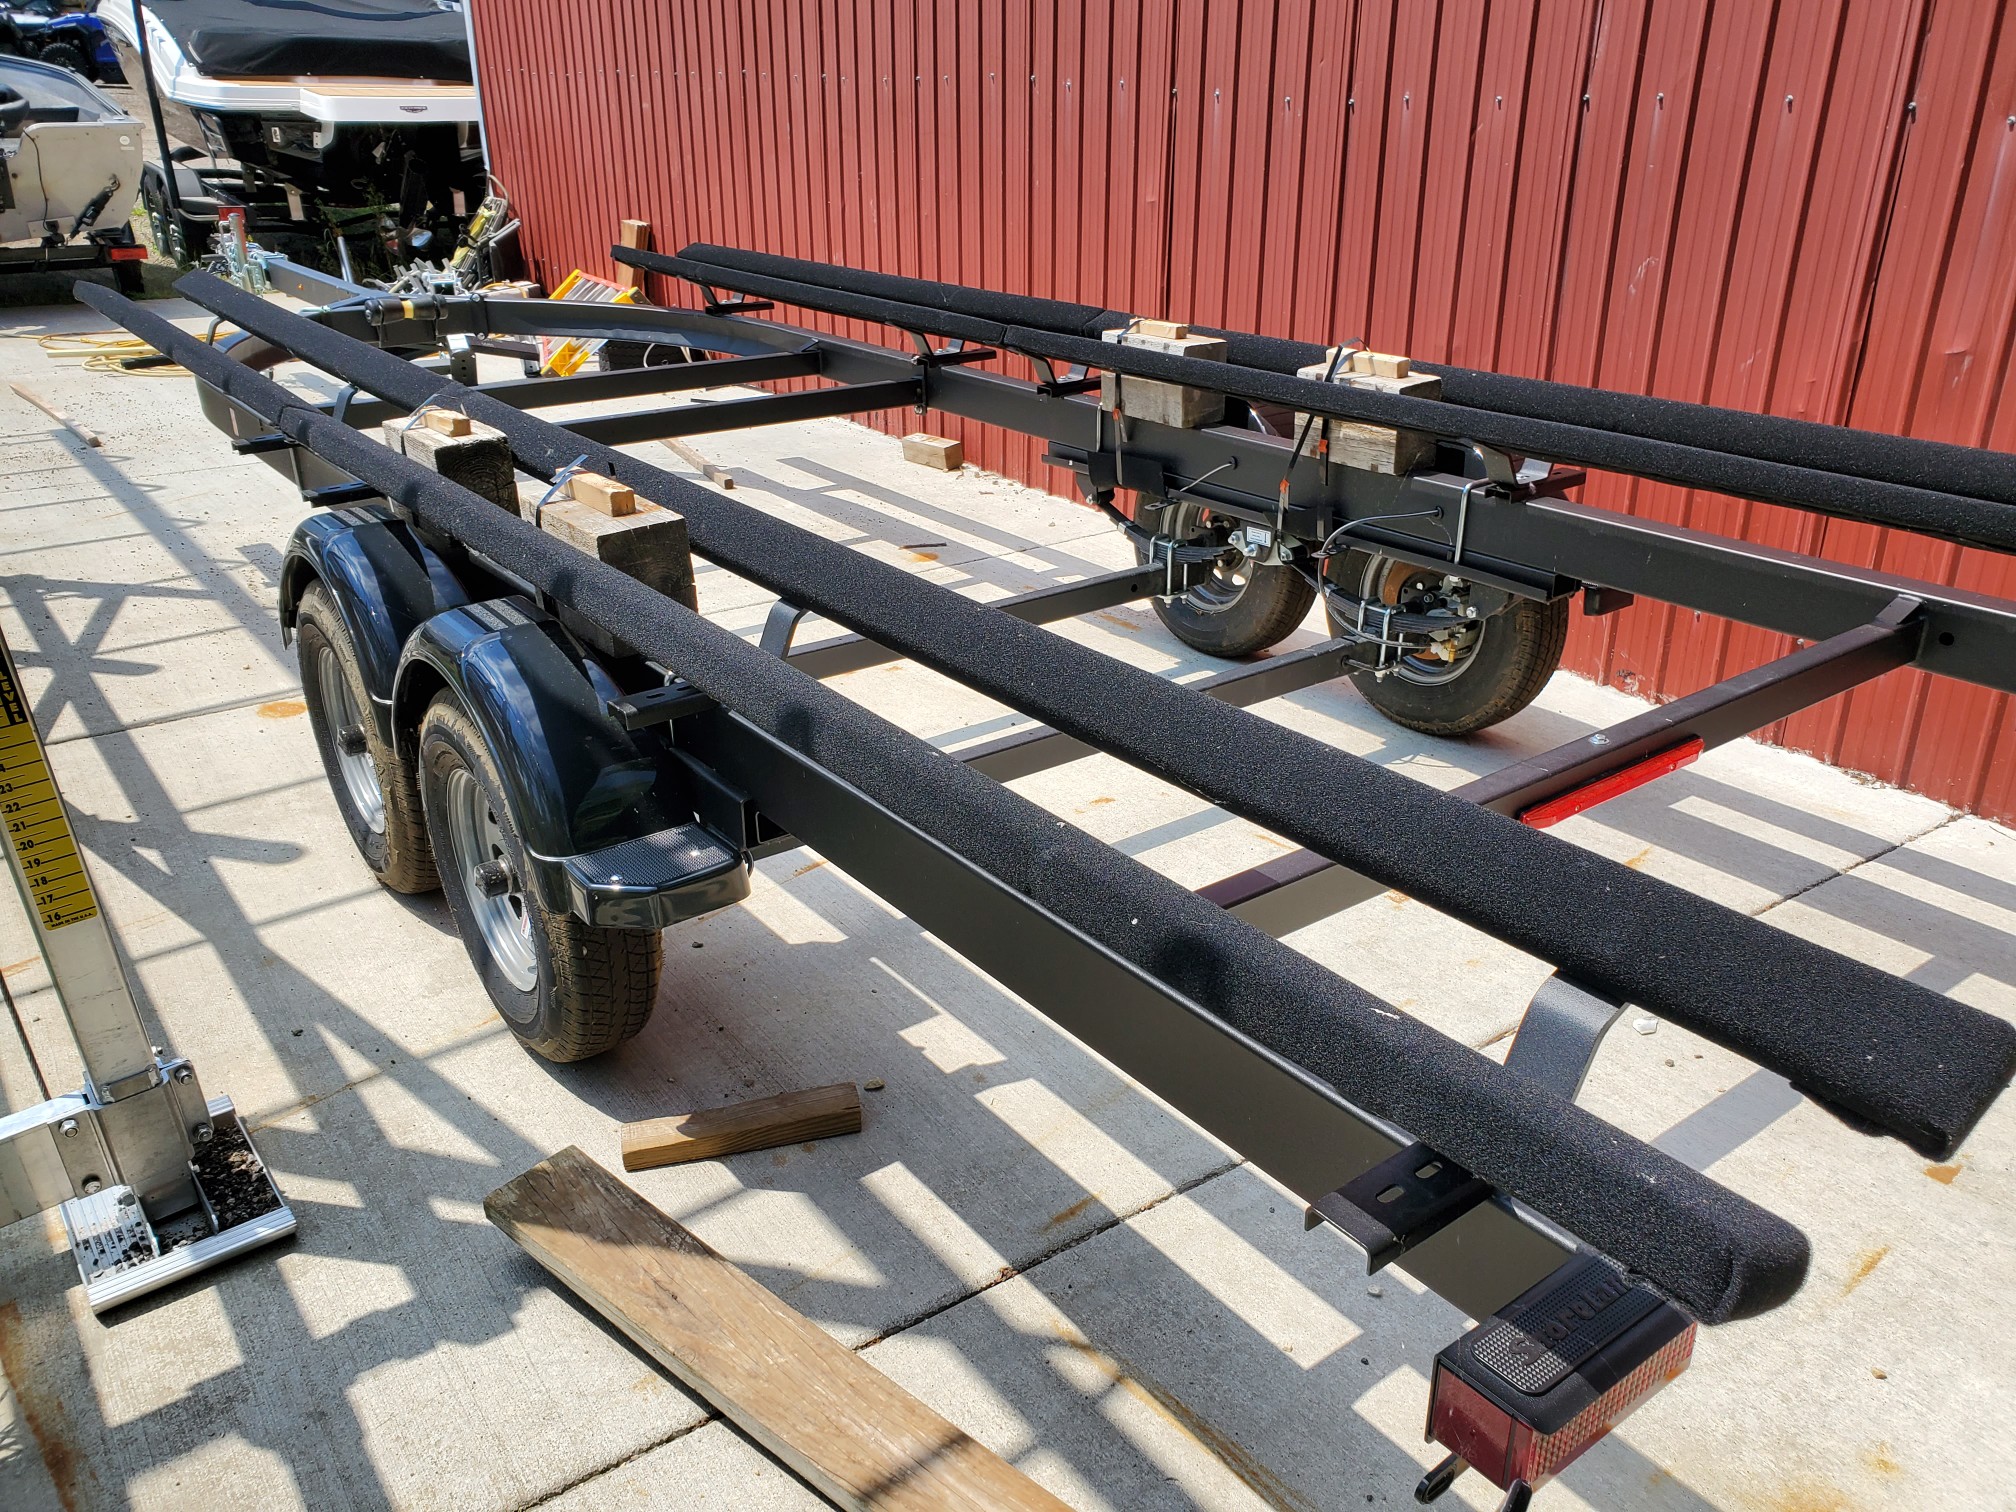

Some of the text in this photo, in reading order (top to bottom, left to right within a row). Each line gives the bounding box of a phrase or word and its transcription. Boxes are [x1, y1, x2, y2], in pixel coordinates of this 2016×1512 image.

[0, 671, 23, 723] LEVEL
[0, 782, 13, 794] 23
[6, 802, 20, 813] 22
[13, 821, 26, 832] 21
[20, 839, 34, 851] 20
[27, 858, 40, 869] 19
[34, 876, 48, 887] 18
[41, 894, 53, 905] 17
[47, 911, 61, 923] 16
[51, 920, 64, 928] MADE
